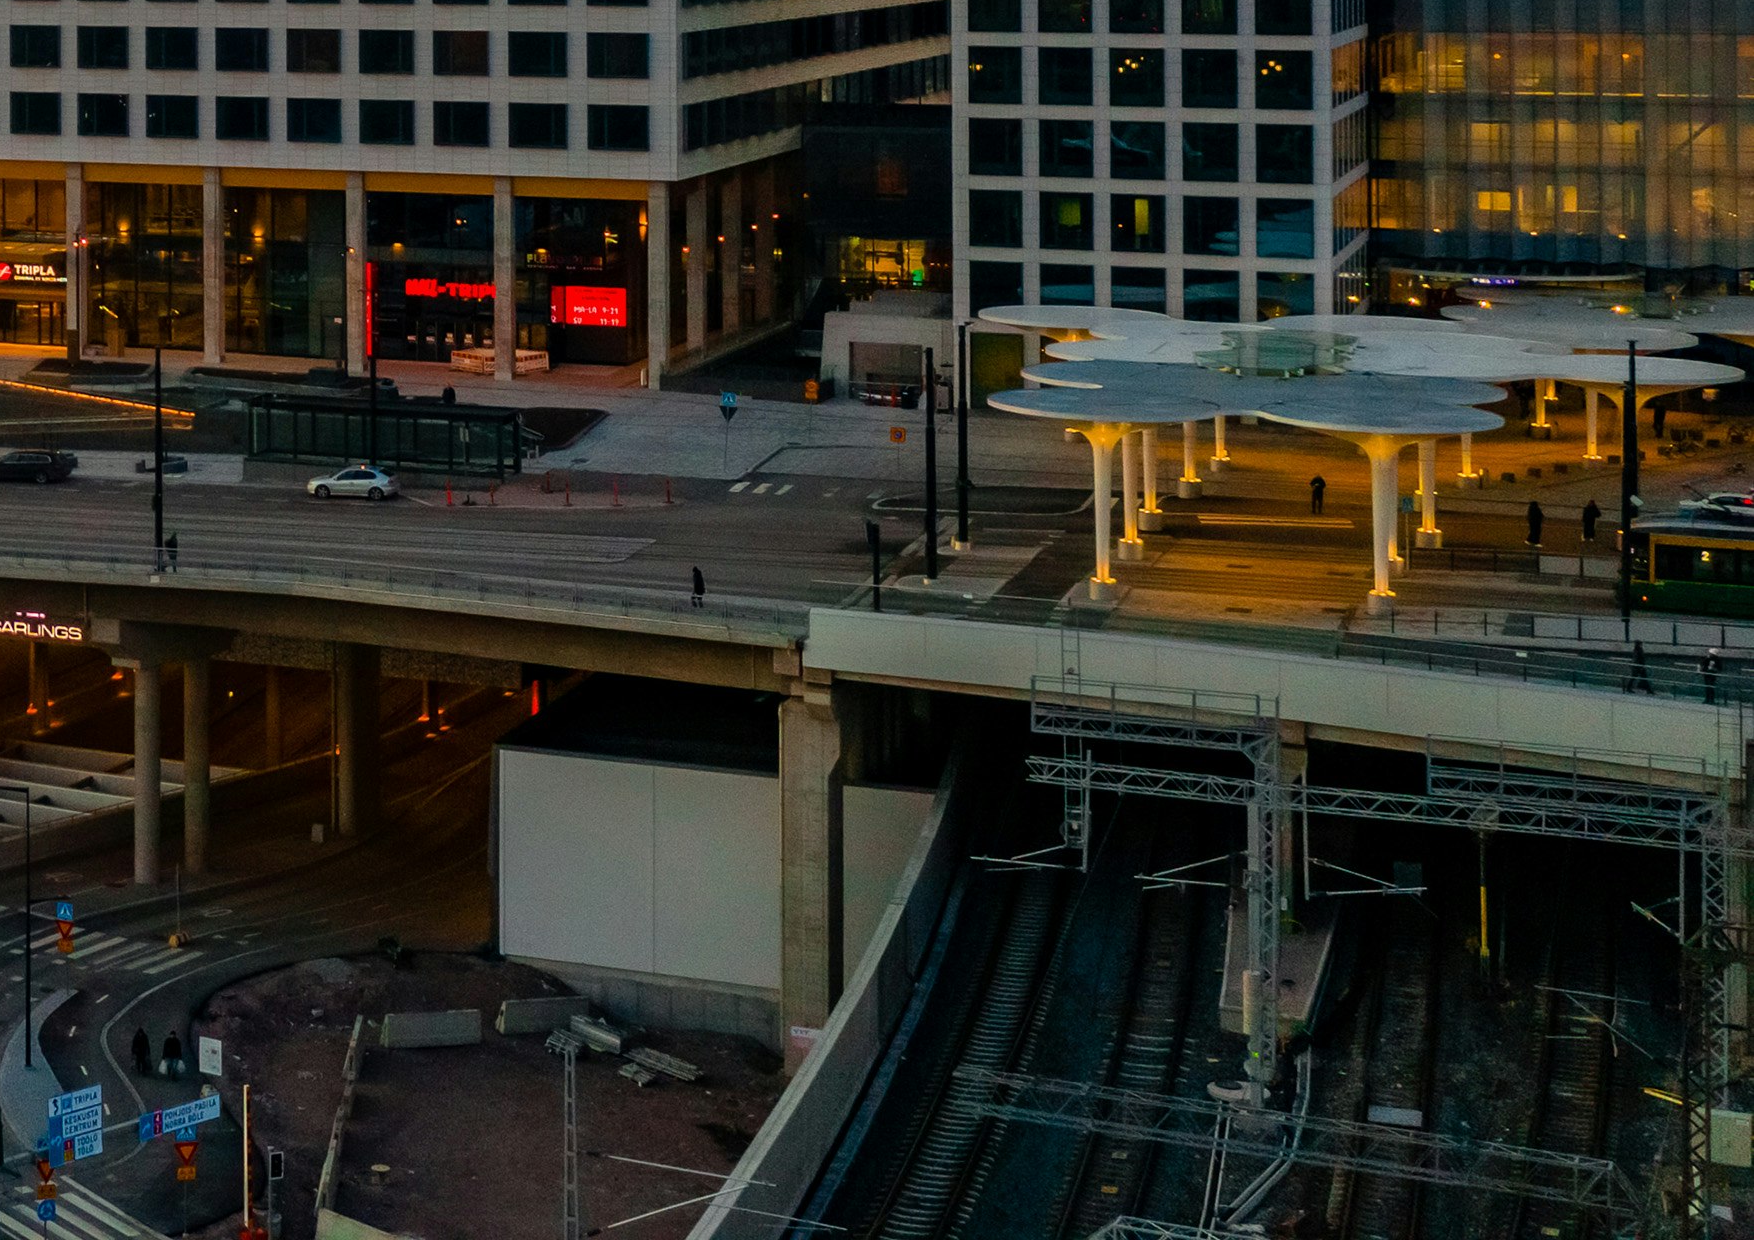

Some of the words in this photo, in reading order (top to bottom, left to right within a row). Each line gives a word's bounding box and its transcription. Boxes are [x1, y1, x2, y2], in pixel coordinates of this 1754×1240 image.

[14, 264, 56, 276] TRIPLA
[1701, 550, 1710, 561] 2
[74, 1091, 98, 1105] TRIPLA
[64, 1108, 99, 1127] KESKUSTA
[65, 1118, 99, 1136] CENTRUM
